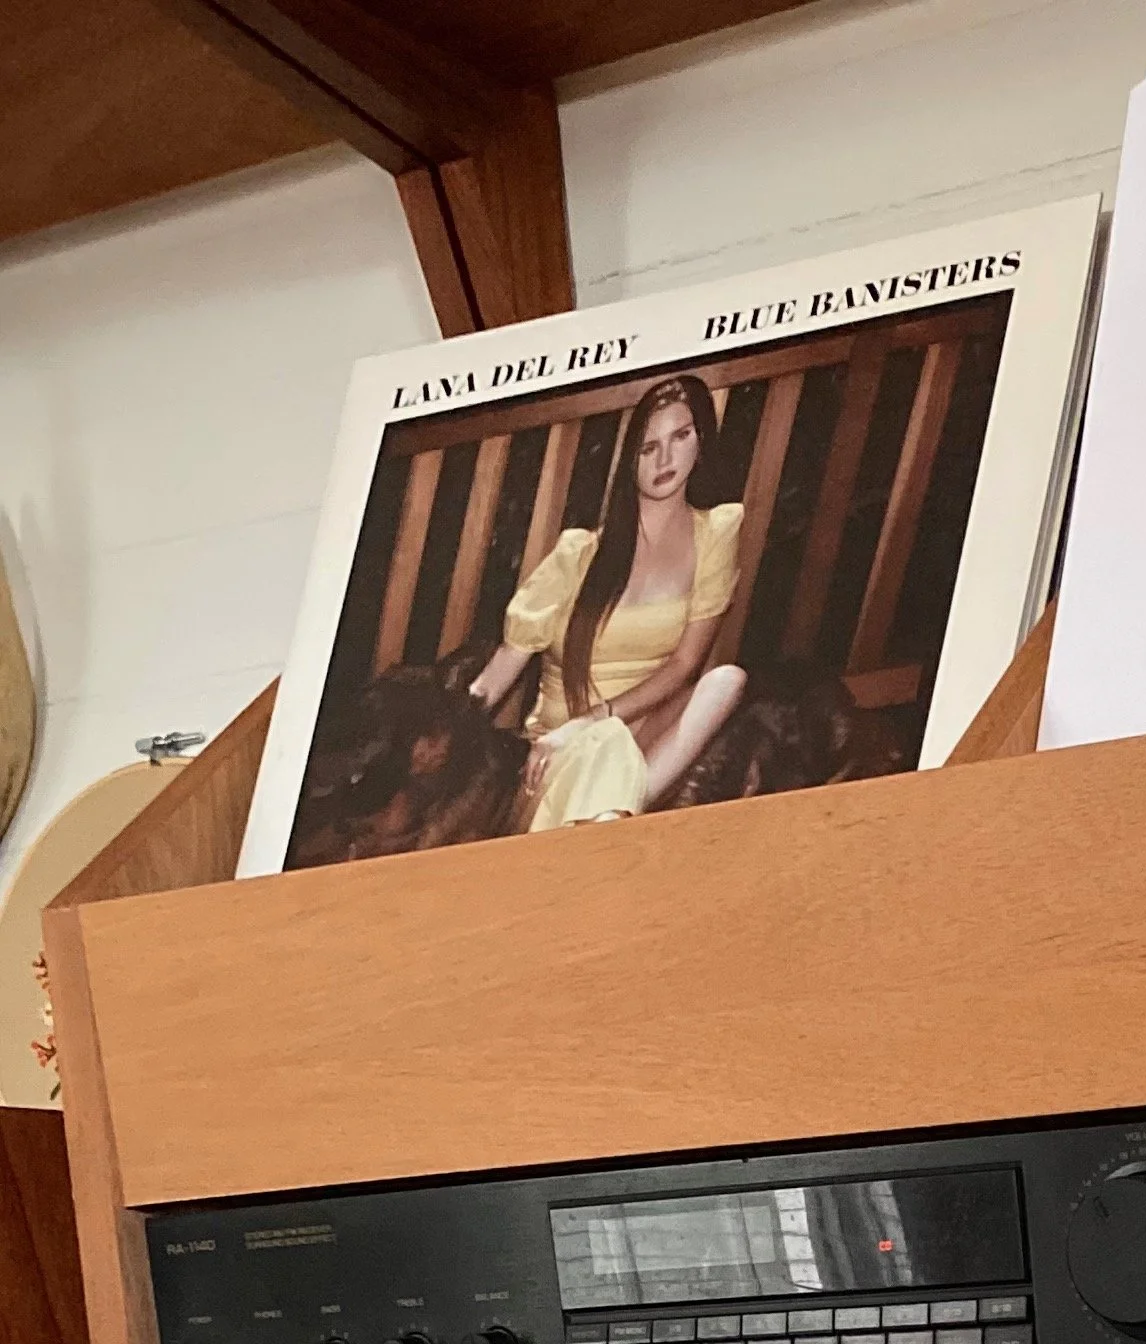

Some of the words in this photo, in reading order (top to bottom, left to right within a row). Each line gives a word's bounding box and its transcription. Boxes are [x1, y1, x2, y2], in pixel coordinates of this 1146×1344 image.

[702, 300, 798, 341] BLUE
[809, 250, 1022, 318] BANISTERS
[391, 371, 477, 409] LANA
[490, 355, 556, 388] DEL
[566, 334, 639, 371] REY
